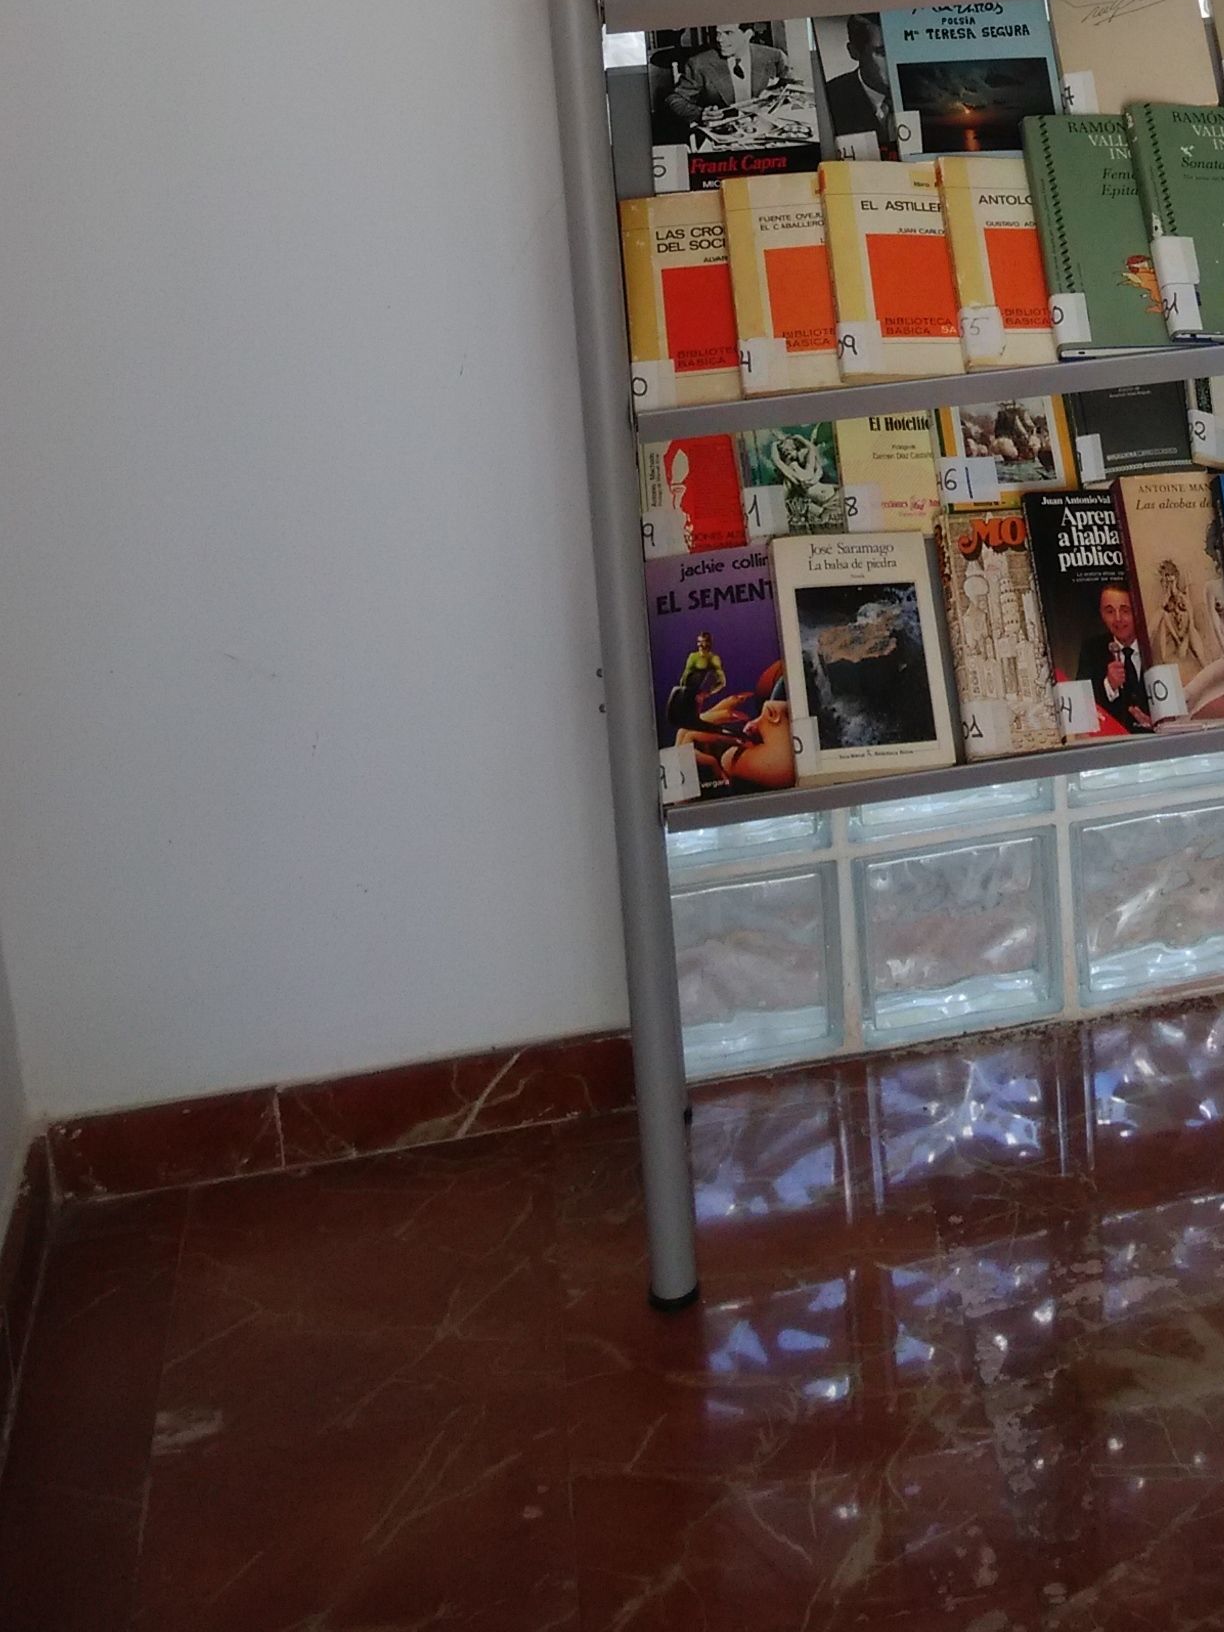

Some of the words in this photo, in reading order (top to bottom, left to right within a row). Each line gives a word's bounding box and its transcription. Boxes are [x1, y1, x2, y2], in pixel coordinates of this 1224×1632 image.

[925, 28, 977, 40] TERESA
[981, 24, 1031, 39] SEGURA
[690, 156, 738, 174] Frank
[740, 154, 788, 171] Capra
[860, 200, 879, 211] EL
[655, 228, 686, 241] LAS
[656, 241, 686, 254] DEL
[869, 416, 881, 432] El
[1137, 484, 1186, 494] ANTOINE
[1040, 496, 1063, 506] Juan
[1064, 495, 1098, 506] Antonio
[1135, 498, 1156, 511] Las
[1158, 497, 1197, 509] alcobas
[1057, 533, 1071, 547] a
[810, 543, 833, 558] José
[837, 542, 895, 555] Saramago
[808, 558, 822, 571] La
[824, 558, 850, 570] balsa
[851, 557, 864, 570] de
[866, 557, 898, 572] piedra
[1057, 546, 1125, 573] público
[679, 559, 725, 582] jackie
[656, 589, 682, 616] EL
